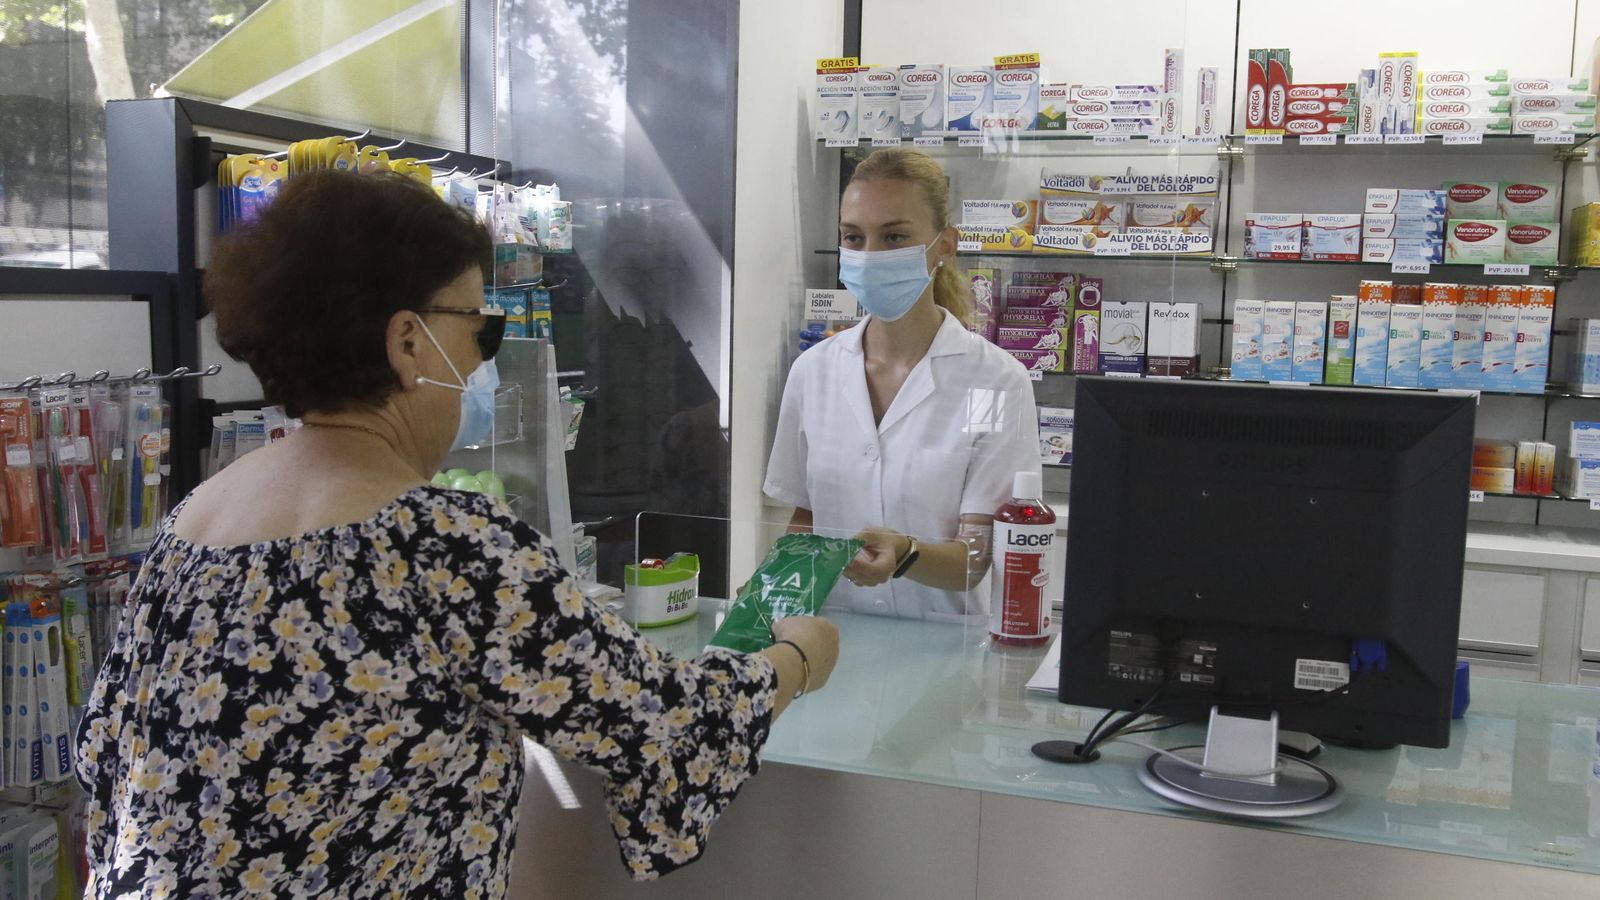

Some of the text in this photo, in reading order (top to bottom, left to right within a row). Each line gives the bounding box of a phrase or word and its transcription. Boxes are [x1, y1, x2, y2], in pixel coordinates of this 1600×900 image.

[820, 58, 854, 68] GRATIS
[1000, 54, 1035, 64] GRATIS
[906, 74, 937, 82] COREGA
[956, 74, 988, 83] COREGA
[1001, 74, 1033, 82] COREGA
[1403, 64, 1412, 98] COREGA
[1251, 90, 1260, 122] COREGA
[1271, 90, 1280, 122] COREGA
[1430, 122, 1465, 130] COREGA
[1044, 178, 1084, 187] Voltadol
[1152, 174, 1172, 184] MÁS
[1175, 174, 1214, 184] RÁPIDO
[959, 233, 1005, 243] Voltadol
[1036, 236, 1079, 245] Voltadol
[1146, 233, 1167, 243] MÁS
[1170, 234, 1209, 244] RÁPIDO
[1153, 243, 1188, 251] DOLOR
[1154, 309, 1190, 318] Revdox
[45, 394, 67, 404] Lacer
[1007, 529, 1053, 546] Lacer
[78, 636, 86, 661] Lacer
[60, 737, 68, 772] VITIS
[32, 743, 41, 779] VITIS
